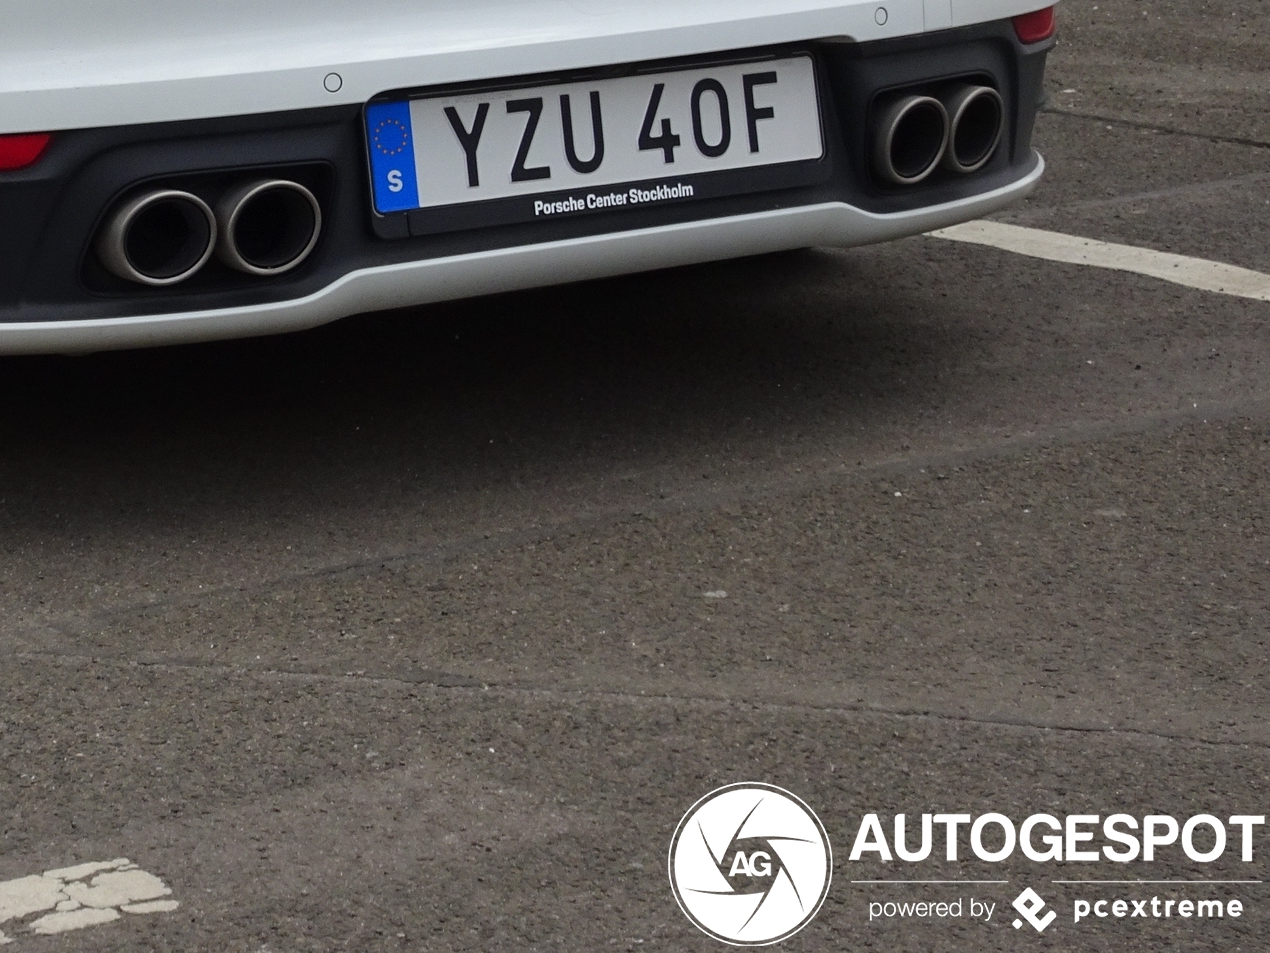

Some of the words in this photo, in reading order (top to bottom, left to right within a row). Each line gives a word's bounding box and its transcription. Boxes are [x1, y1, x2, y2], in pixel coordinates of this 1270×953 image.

[443, 90, 606, 188] YZU
[637, 71, 778, 164] 40F
[387, 169, 404, 193] S
[534, 197, 585, 216] Porsche
[586, 192, 628, 209] Center
[629, 182, 694, 203] Stockholm
